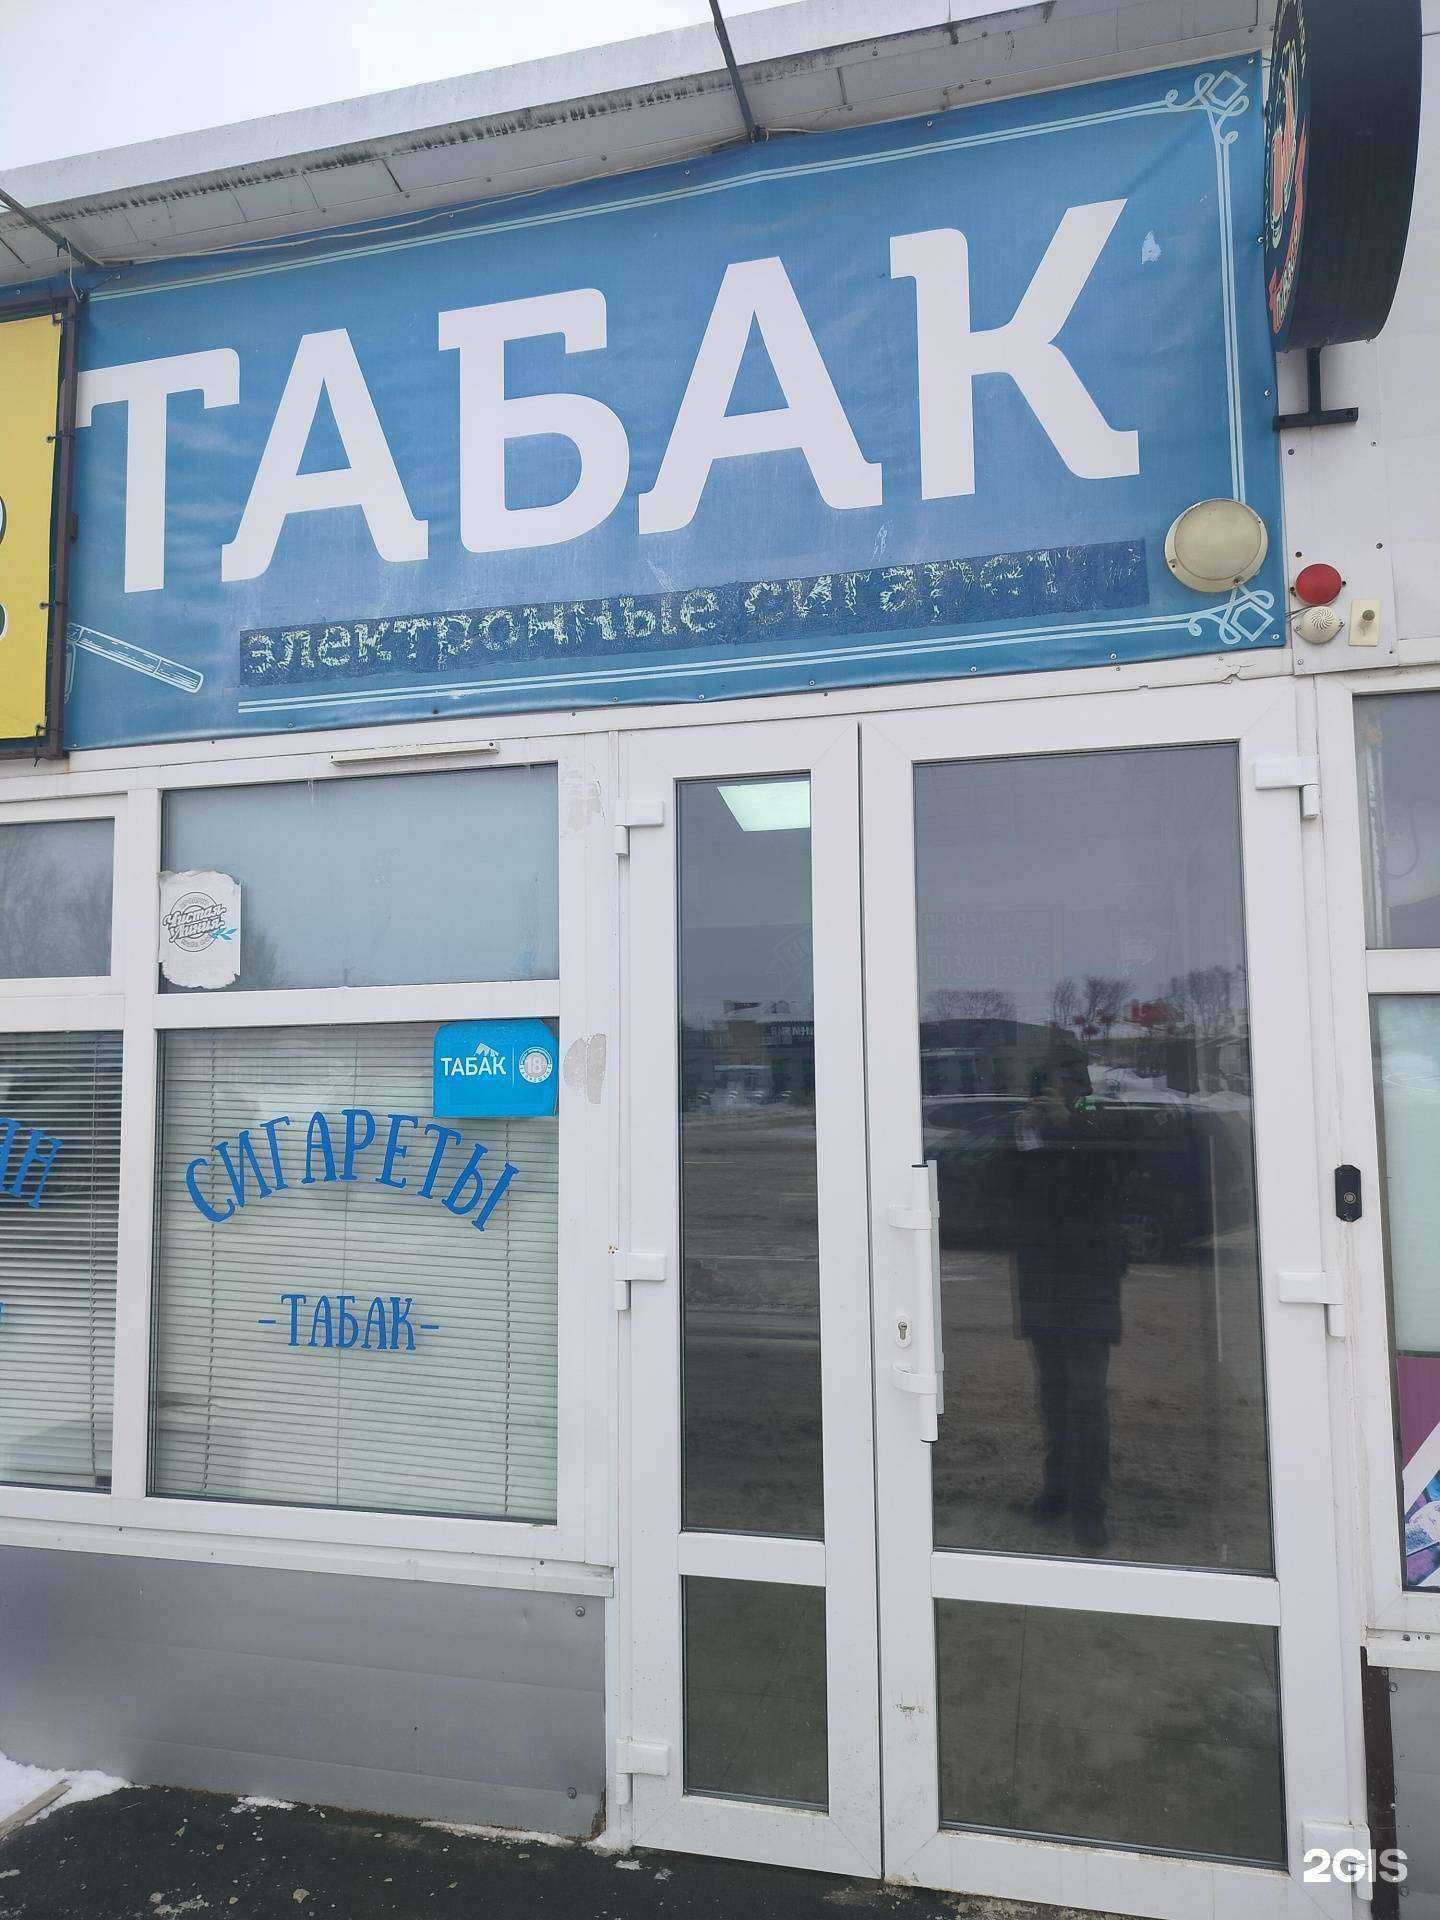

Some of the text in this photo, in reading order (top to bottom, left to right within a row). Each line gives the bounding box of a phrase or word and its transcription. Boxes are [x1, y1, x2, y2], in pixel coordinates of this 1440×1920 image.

[77, 198, 1140, 594] ТАБАК
[440, 1055, 507, 1076] ТАБАК
[185, 1109, 519, 1232] СИГАРЕТЫ
